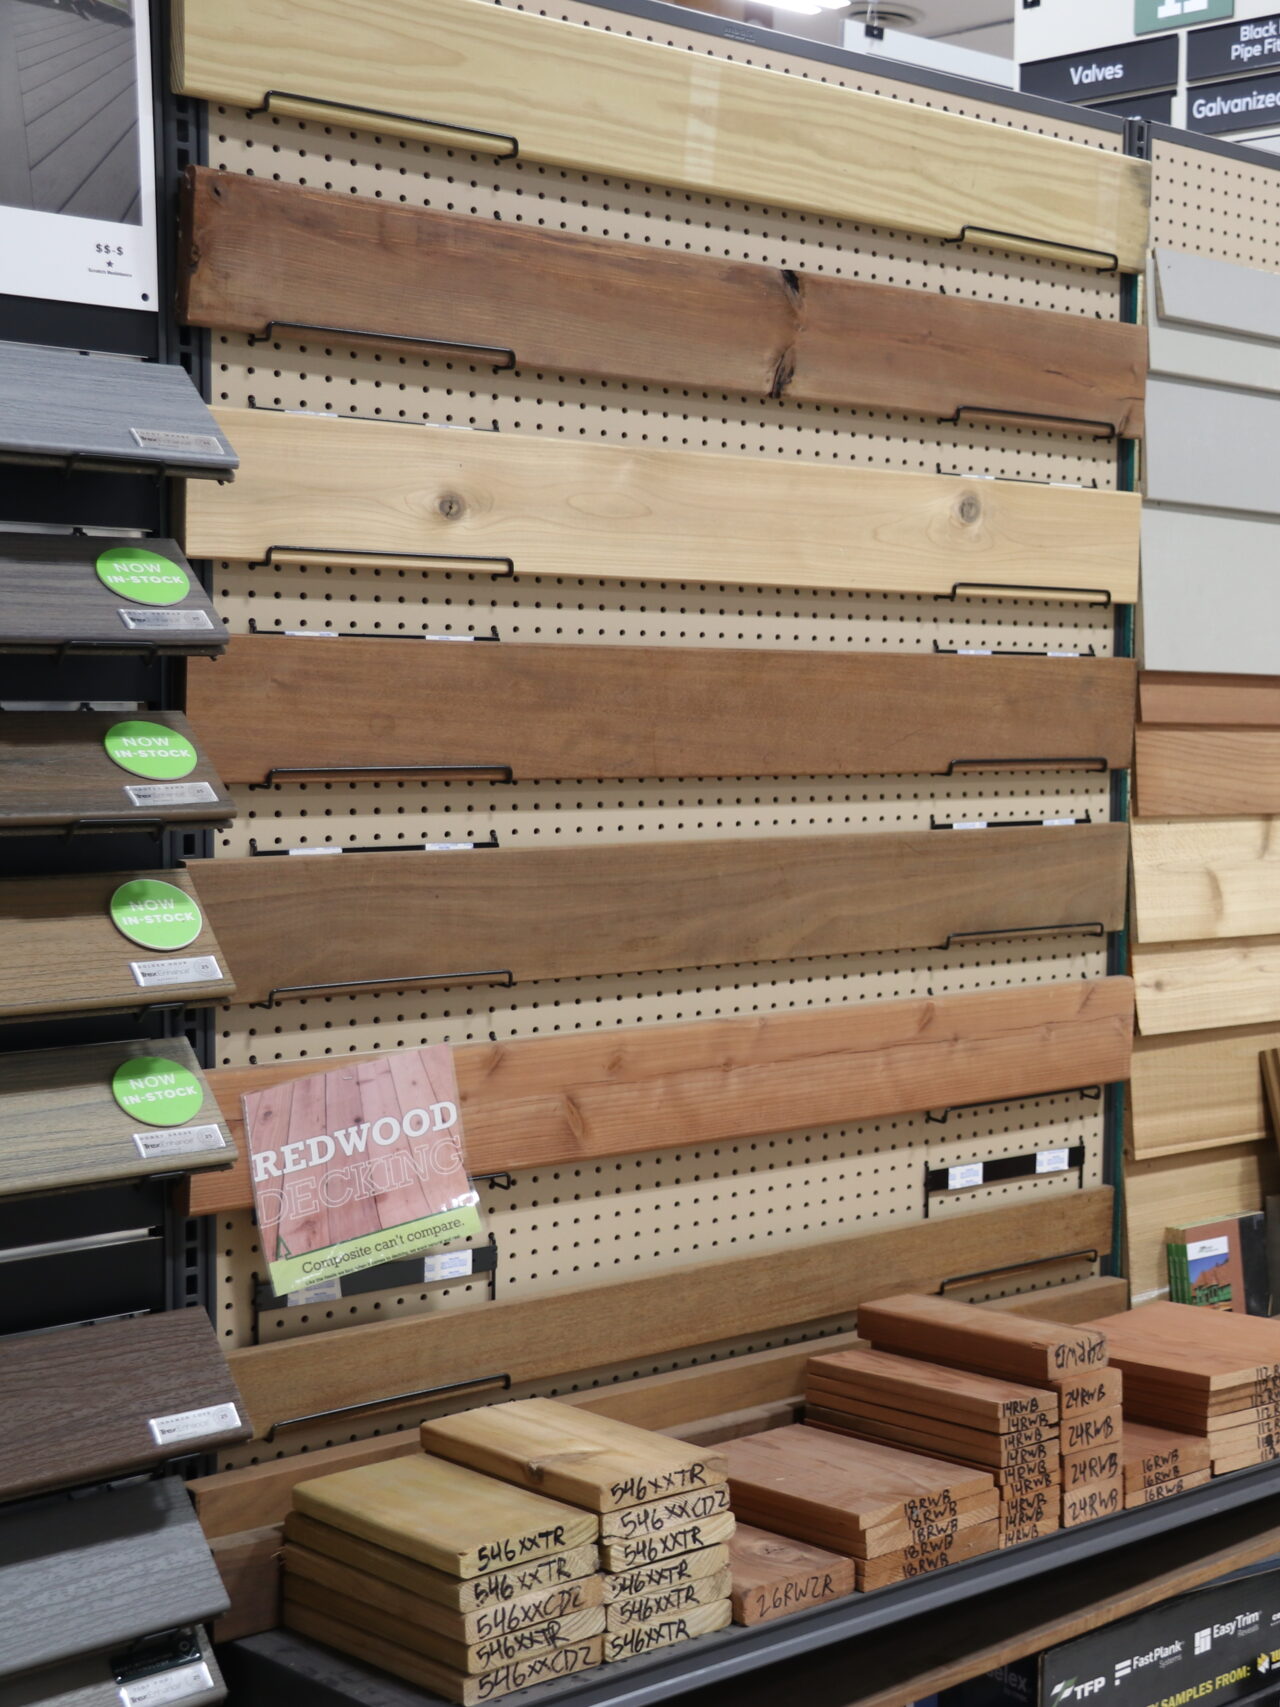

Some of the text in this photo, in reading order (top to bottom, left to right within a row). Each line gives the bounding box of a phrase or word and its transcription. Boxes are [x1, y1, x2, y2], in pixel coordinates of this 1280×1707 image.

[1240, 22, 1278, 41] Black
[1231, 42, 1262, 61] Pipe
[1070, 63, 1124, 85] Valves
[106, 575, 185, 584] IN-STOCK
[113, 562, 161, 574] NOW
[122, 736, 170, 747] NOW
[114, 749, 191, 758] IN-STOCK
[129, 898, 175, 911] NOW
[122, 912, 195, 926] IN-STOCK
[129, 1073, 176, 1090] NOW
[122, 1086, 198, 1105] IN-STOCK
[251, 1101, 458, 1182] REDWOOD
[256, 1135, 464, 1229] DECKING
[302, 1218, 465, 1274] Composite can't compare.
[1002, 1397, 1039, 1418] 14RWB
[1065, 1384, 1106, 1408] 24RWB
[1008, 1413, 1048, 1431] 14RWB
[1069, 1416, 1113, 1447] 24RWB
[1005, 1428, 1042, 1449] 14RWB
[1007, 1444, 1046, 1466] 14RWB
[1142, 1449, 1179, 1473] 16RWB
[1005, 1460, 1046, 1482] 14RWB
[1072, 1452, 1118, 1484] 24RWB
[1143, 1465, 1179, 1488] 16RWB
[1011, 1473, 1052, 1497] 14RWB
[1144, 1479, 1183, 1501] 16RWB
[904, 1489, 950, 1516] 18RWB
[1007, 1493, 1047, 1515] 14RWB
[1068, 1488, 1118, 1521] 24RWB
[908, 1501, 957, 1530] 18RWB
[1006, 1506, 1043, 1530] 14RWB
[912, 1518, 958, 1544] 18RWB
[1005, 1524, 1038, 1546] 14RWB
[904, 1533, 953, 1560] 18RWB
[903, 1552, 948, 1577] 18RWB
[1213, 1611, 1260, 1638] EasyTrim
[1133, 1640, 1182, 1669] FastPlank
[1074, 1677, 1106, 1700] TFP
[1161, 1665, 1251, 1707] SAMPLES FROM:
